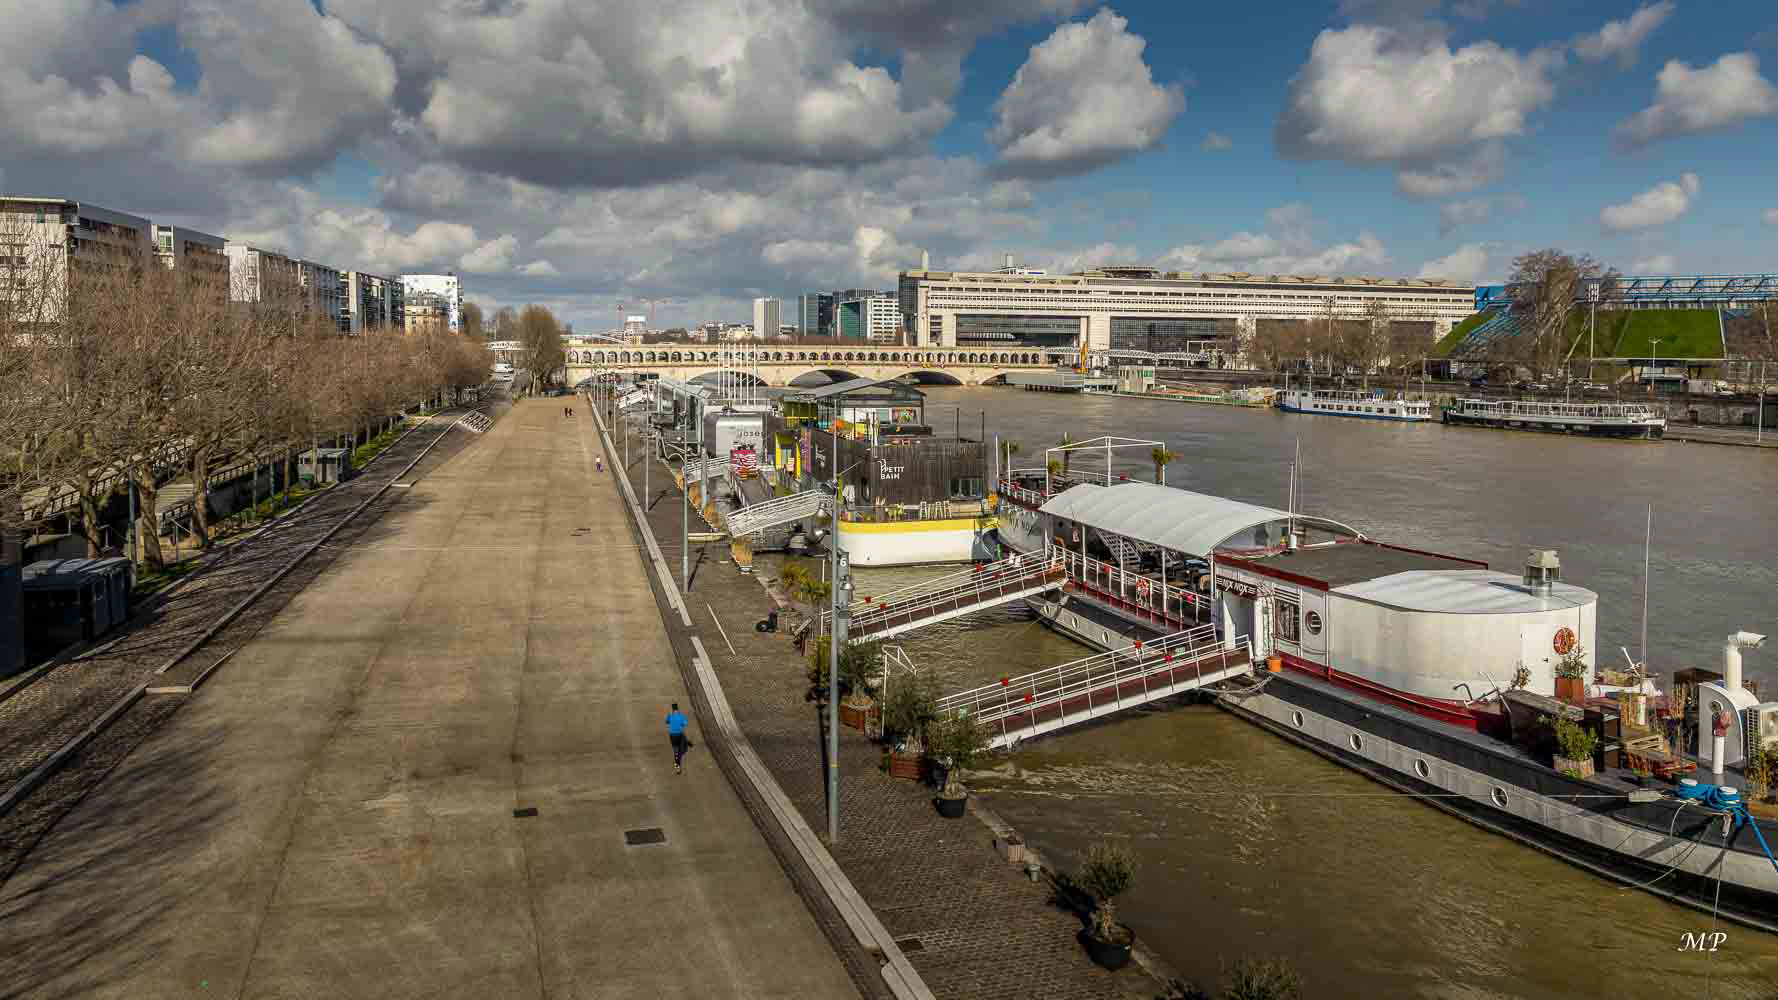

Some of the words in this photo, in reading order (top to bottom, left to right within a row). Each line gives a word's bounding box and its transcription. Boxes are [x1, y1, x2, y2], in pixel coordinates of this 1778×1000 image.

[884, 465, 905, 473] PETIT
[840, 557, 847, 567] 6
[1222, 578, 1234, 592] NIX
[1234, 582, 1249, 596] NOX
